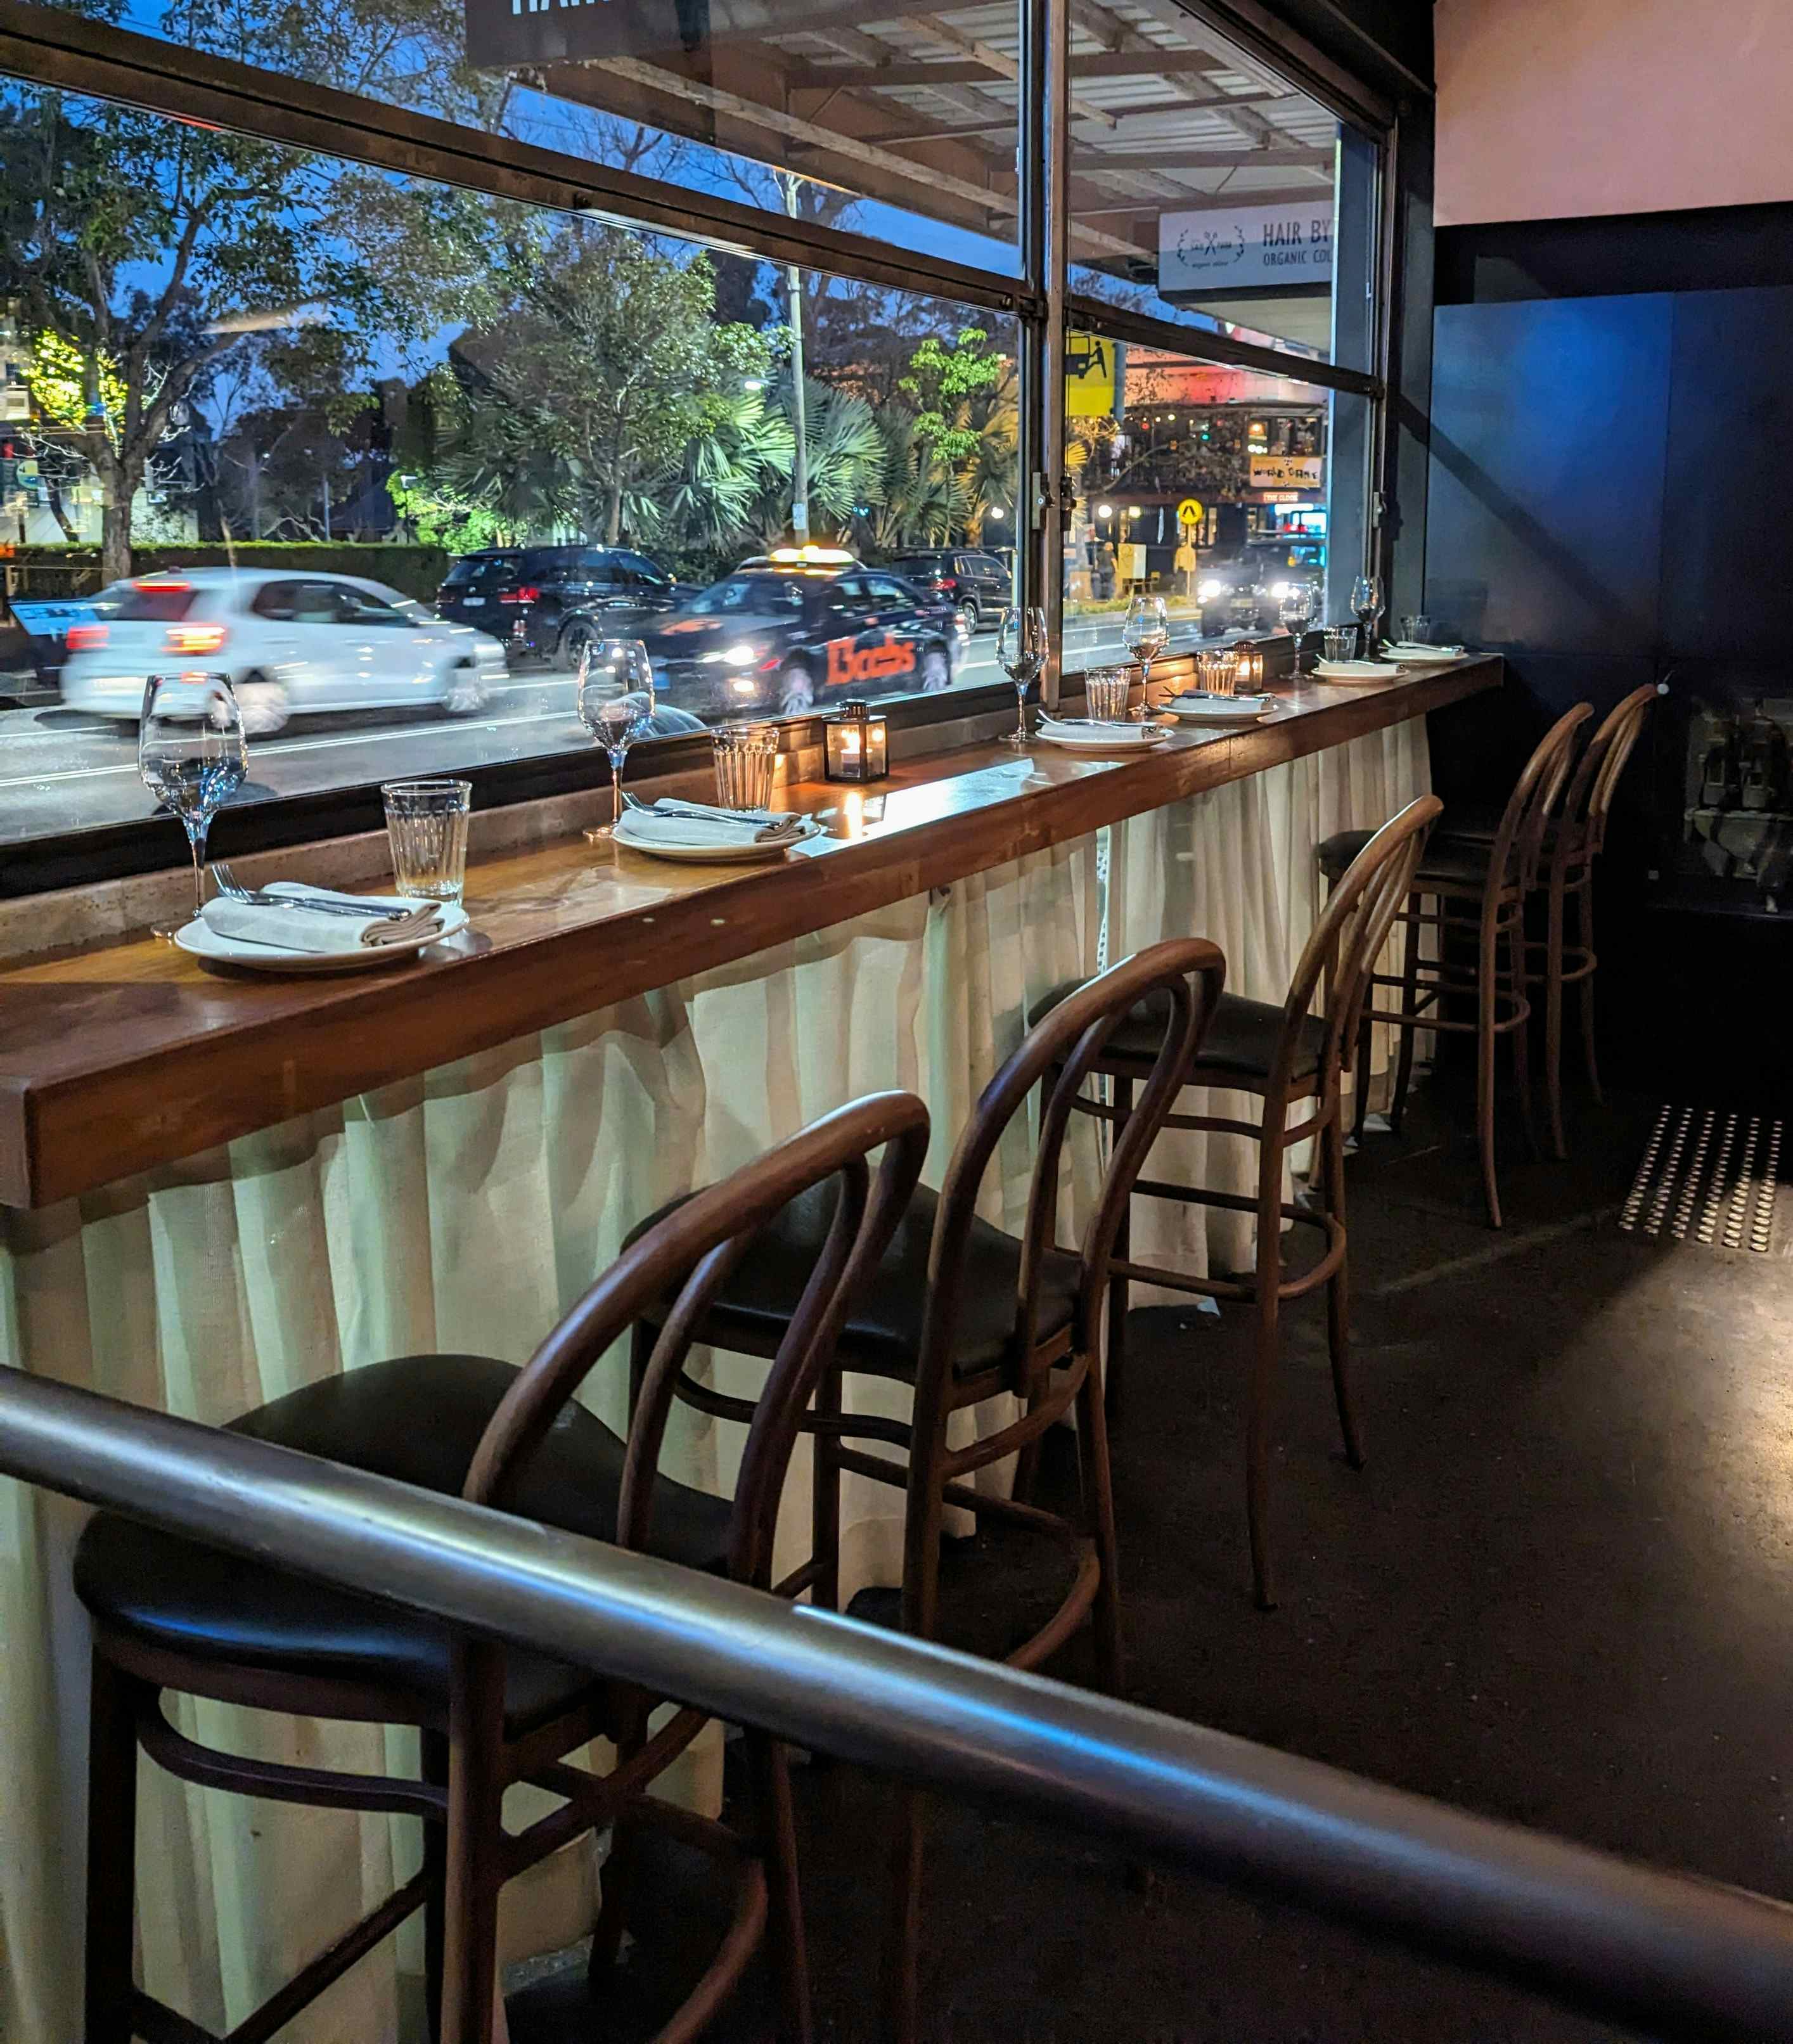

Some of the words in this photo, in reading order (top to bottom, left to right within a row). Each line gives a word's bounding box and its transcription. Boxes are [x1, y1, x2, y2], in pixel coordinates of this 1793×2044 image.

[1263, 222, 1301, 246] HAIR
[1311, 220, 1331, 243] BY
[1263, 250, 1307, 265] ORGANIC
